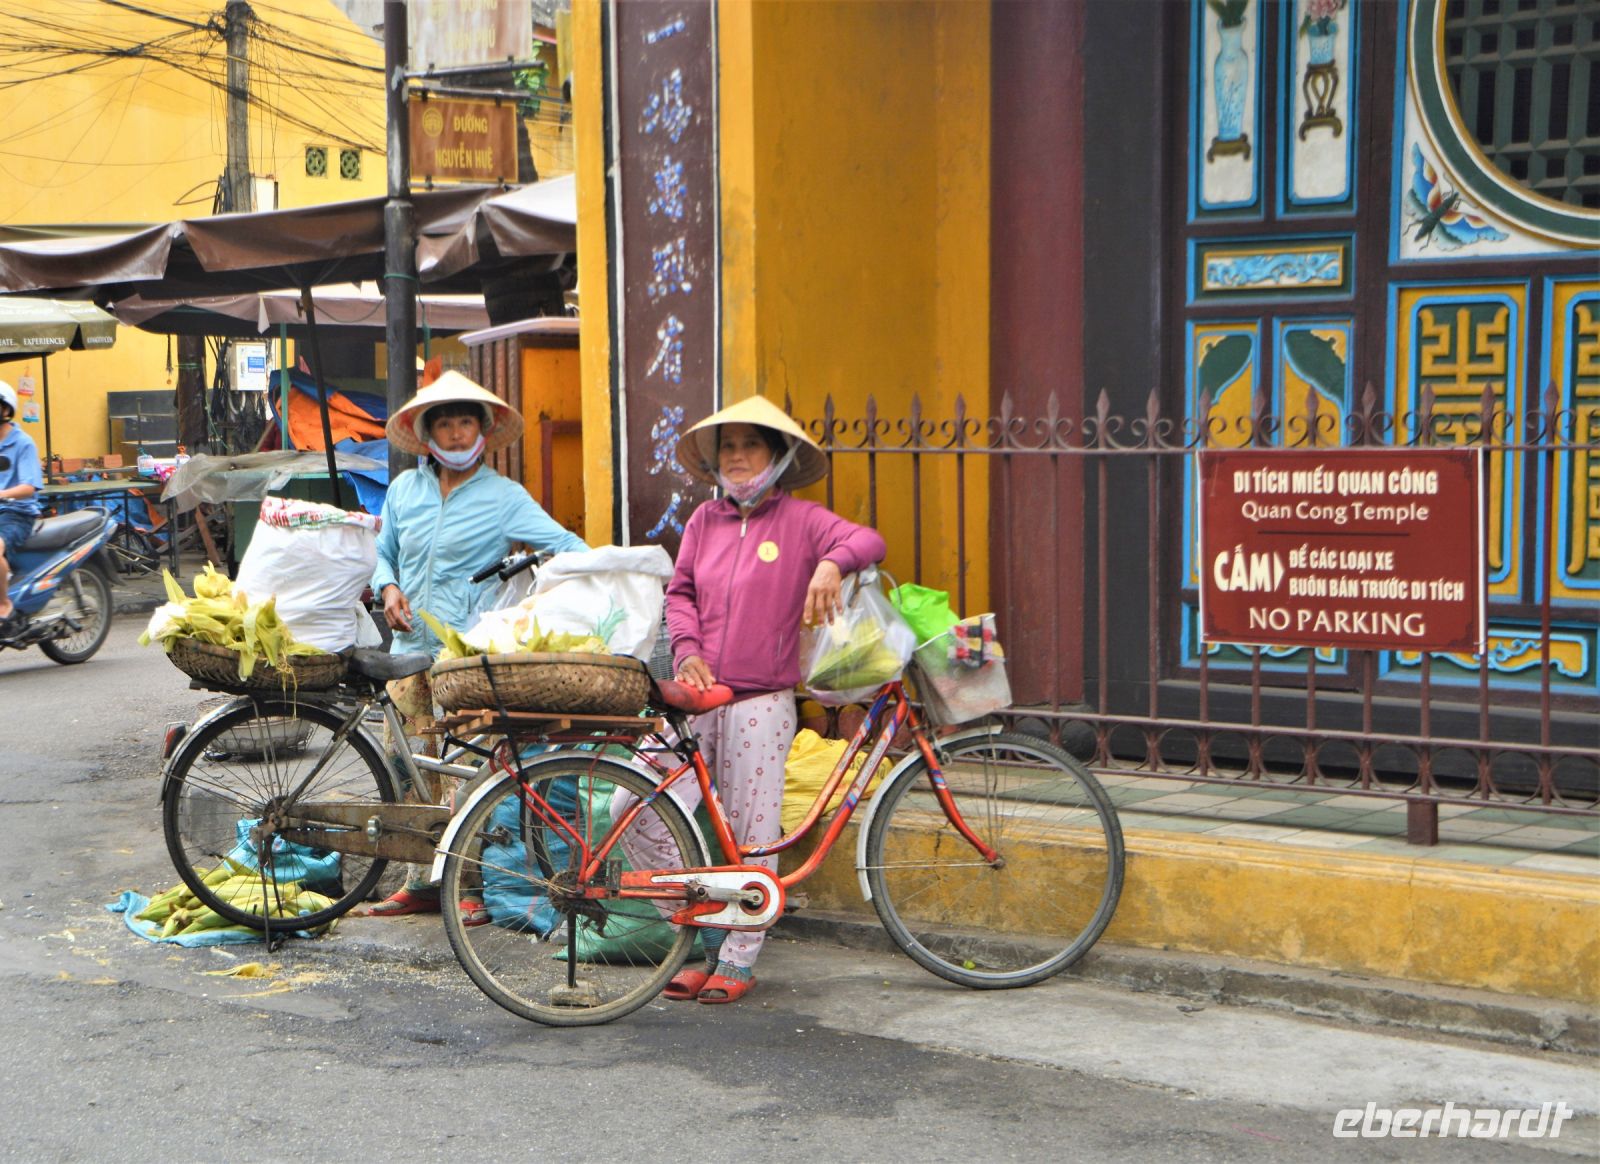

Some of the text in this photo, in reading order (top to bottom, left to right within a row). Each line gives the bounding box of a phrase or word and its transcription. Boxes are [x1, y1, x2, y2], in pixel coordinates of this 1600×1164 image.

[23, 337, 66, 346] EXPERIENCES
[1234, 464, 1438, 496] DI TÍCH MIẾU QUAN CÔNG
[1241, 501, 1430, 525] Quan Cong Temple
[1213, 543, 1272, 592] CẤM
[1309, 546, 1337, 570] CÁC
[1340, 550, 1372, 574] LOẠI
[1375, 552, 1394, 571] XE
[1289, 574, 1465, 602] BUÔN BÁN TRƯỚC DI TÍCH
[1249, 606, 1426, 637] NO PARKING
